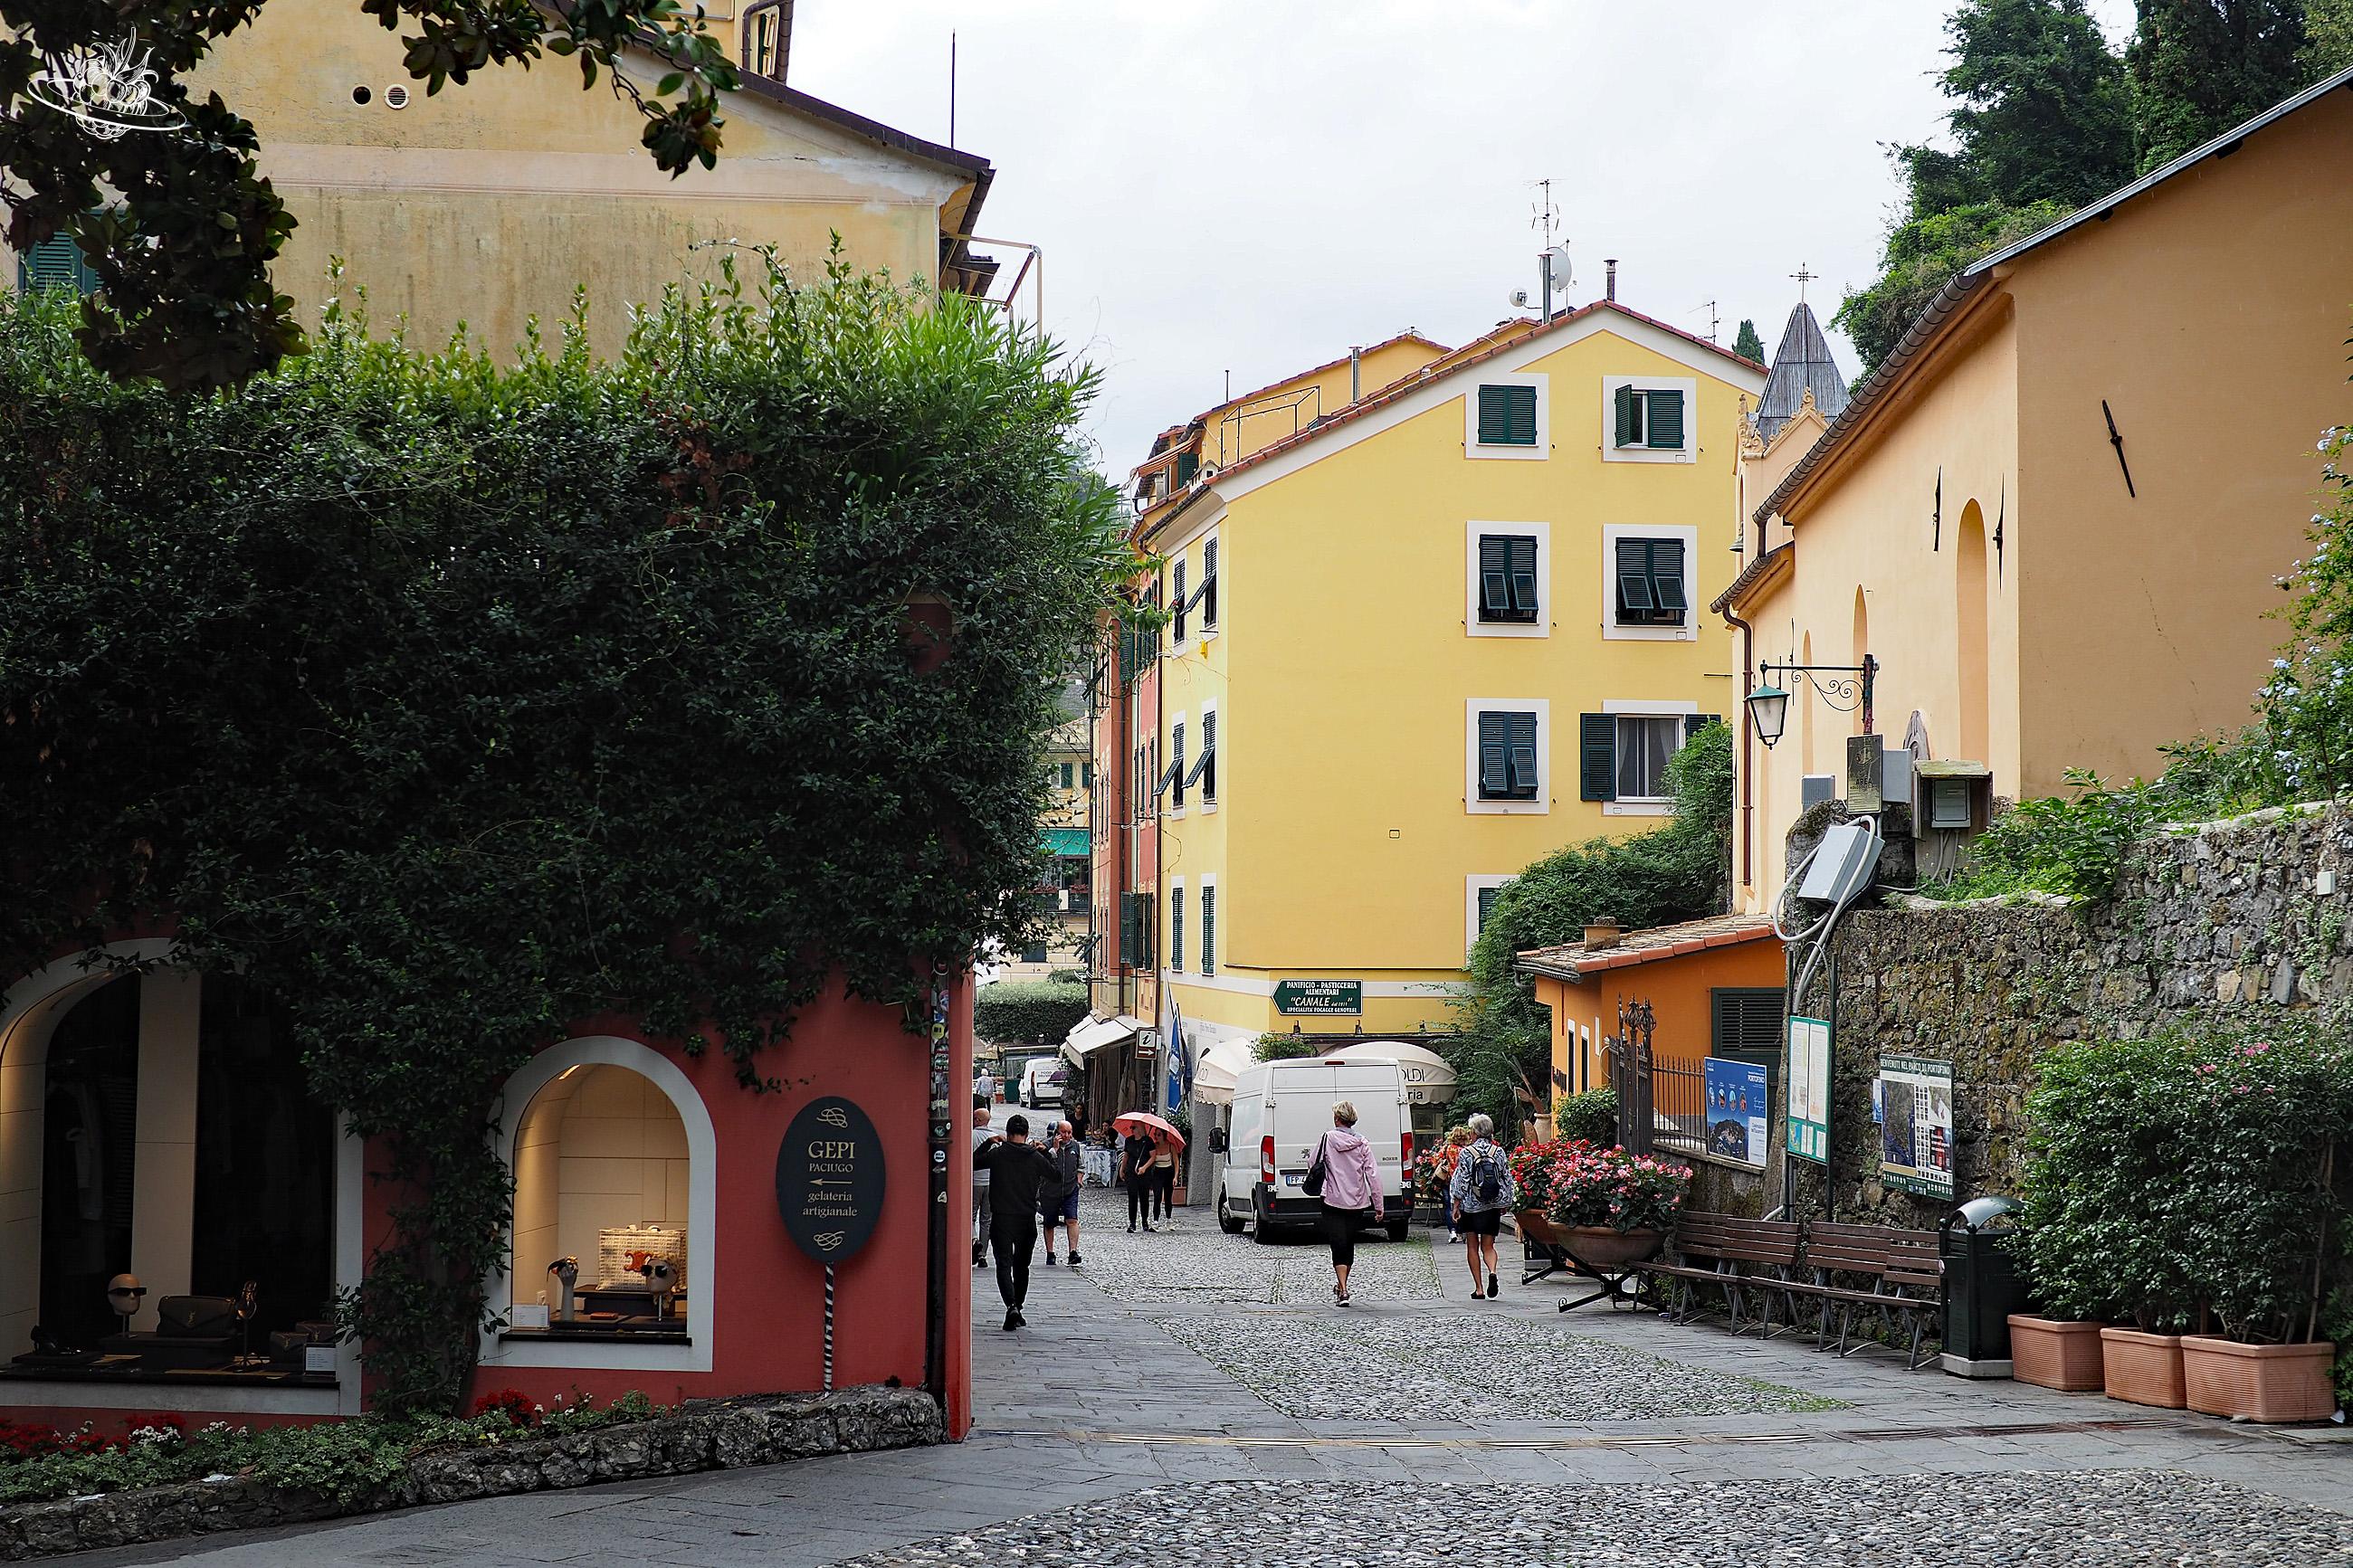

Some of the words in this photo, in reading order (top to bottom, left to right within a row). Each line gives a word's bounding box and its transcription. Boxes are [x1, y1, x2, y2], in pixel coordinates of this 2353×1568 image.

[1880, 1059, 1900, 1069] BENVENUTI
[1900, 1061, 1909, 1070] NEL
[1927, 1064, 1950, 1075] PORTOFINO
[808, 1141, 855, 1159] GEPI
[809, 1163, 853, 1173] PACIUGO
[808, 1191, 853, 1202] gelateria
[803, 1206, 858, 1218] artigianale
